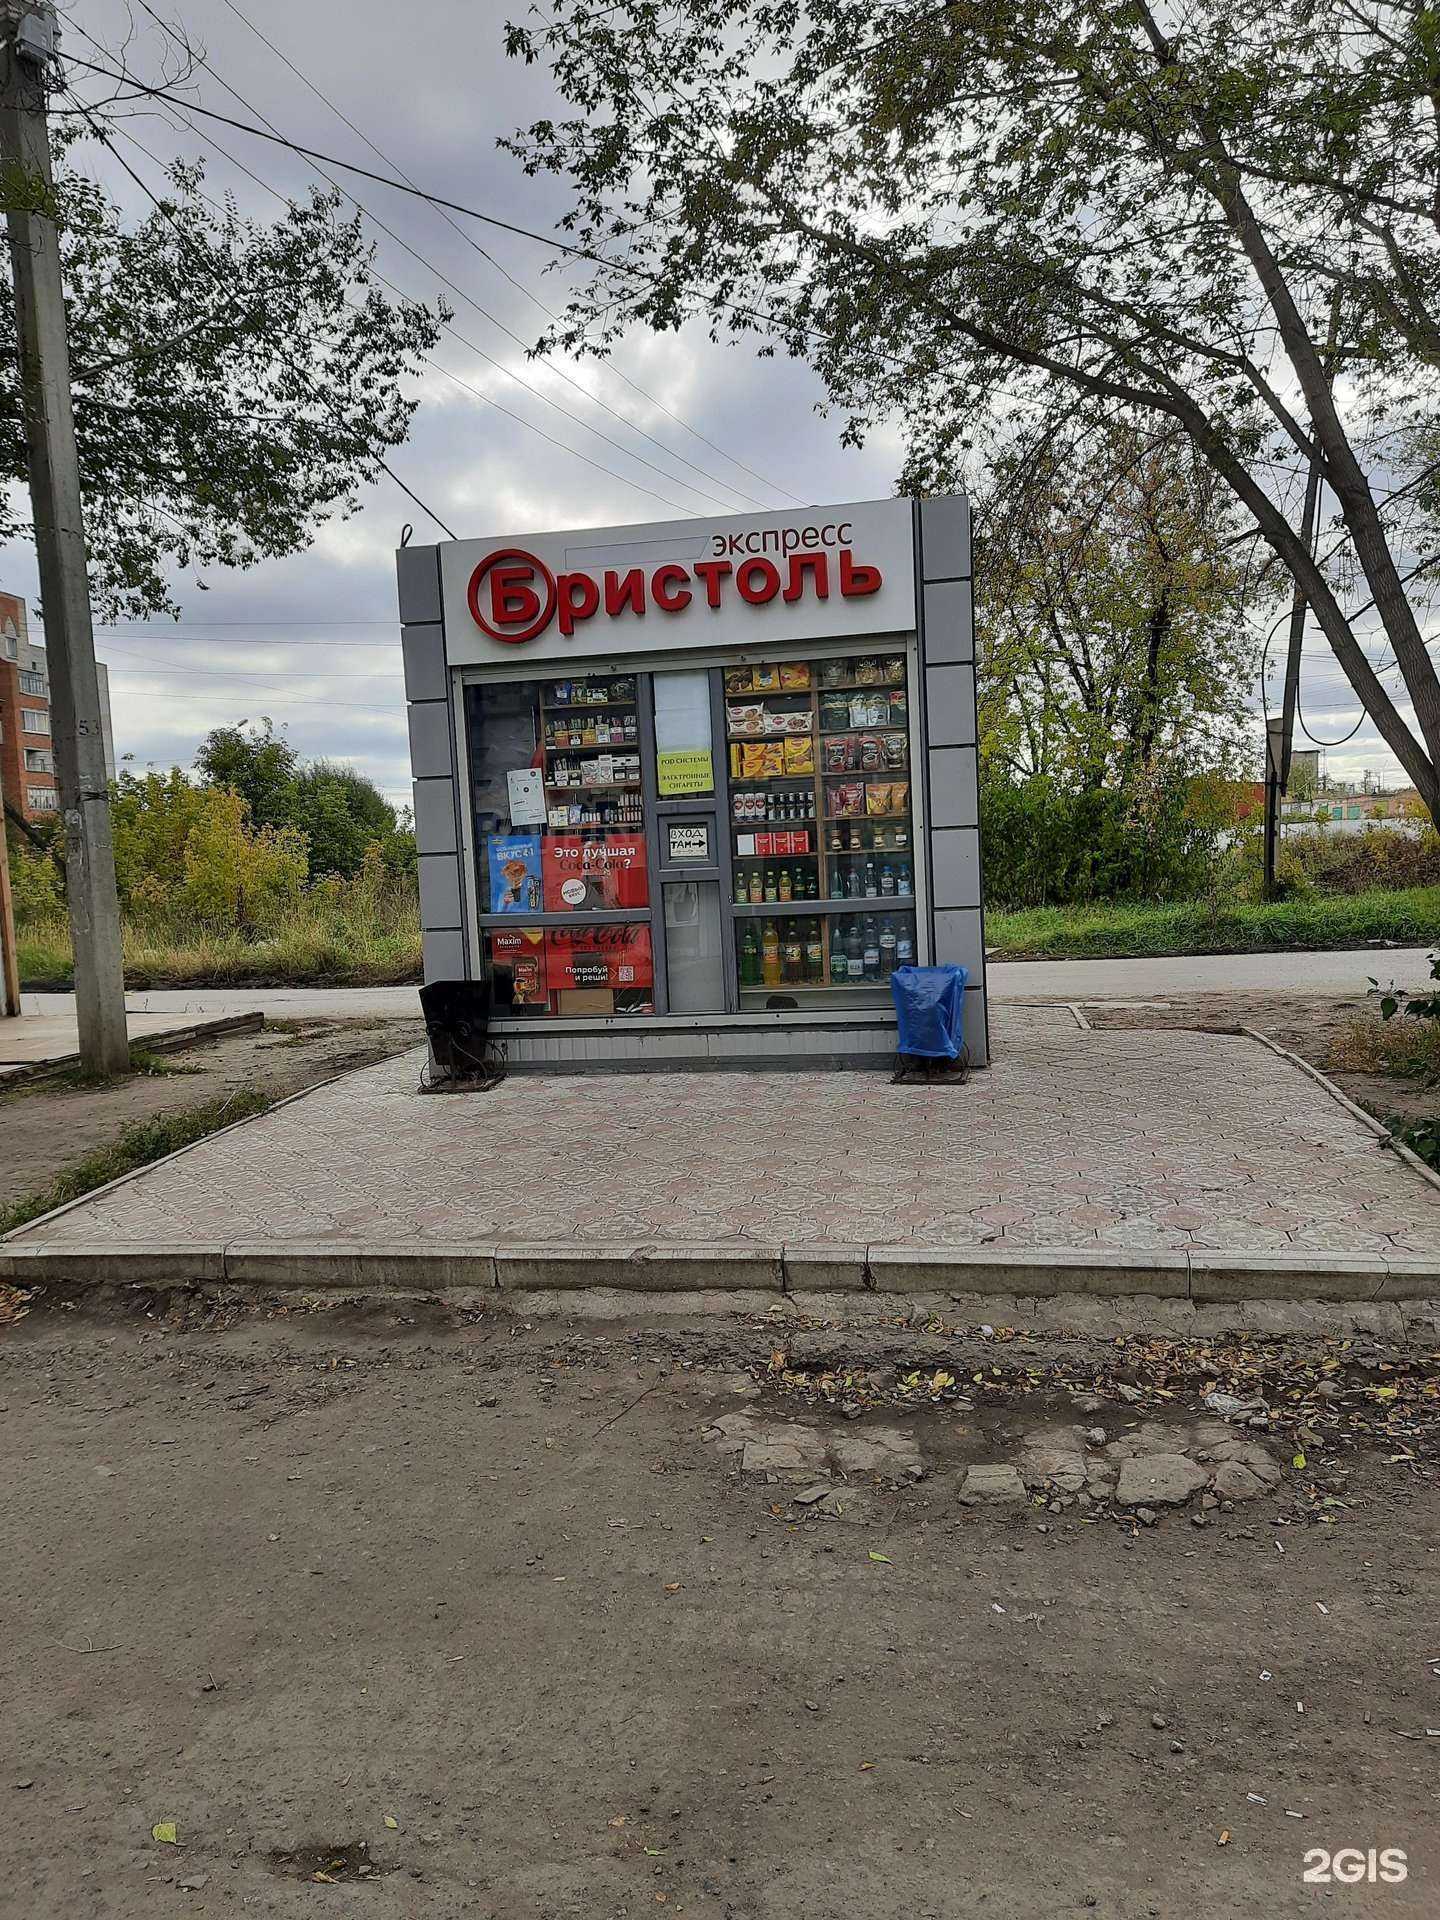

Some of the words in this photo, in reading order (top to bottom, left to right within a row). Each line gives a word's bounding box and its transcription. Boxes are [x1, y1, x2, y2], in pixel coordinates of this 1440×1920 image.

[711, 522, 853, 558] экспресс
[487, 549, 883, 637] Бристоль
[669, 781, 703, 789] СИГАРЕТЫ
[671, 829, 703, 839] ВХОД
[670, 840, 692, 849] ТАМ
[554, 847, 579, 858] Это
[582, 846, 636, 859] лучшая
[497, 934, 522, 946] Maxim
[565, 965, 608, 975] Попробуй
[582, 974, 609, 982] реши!
